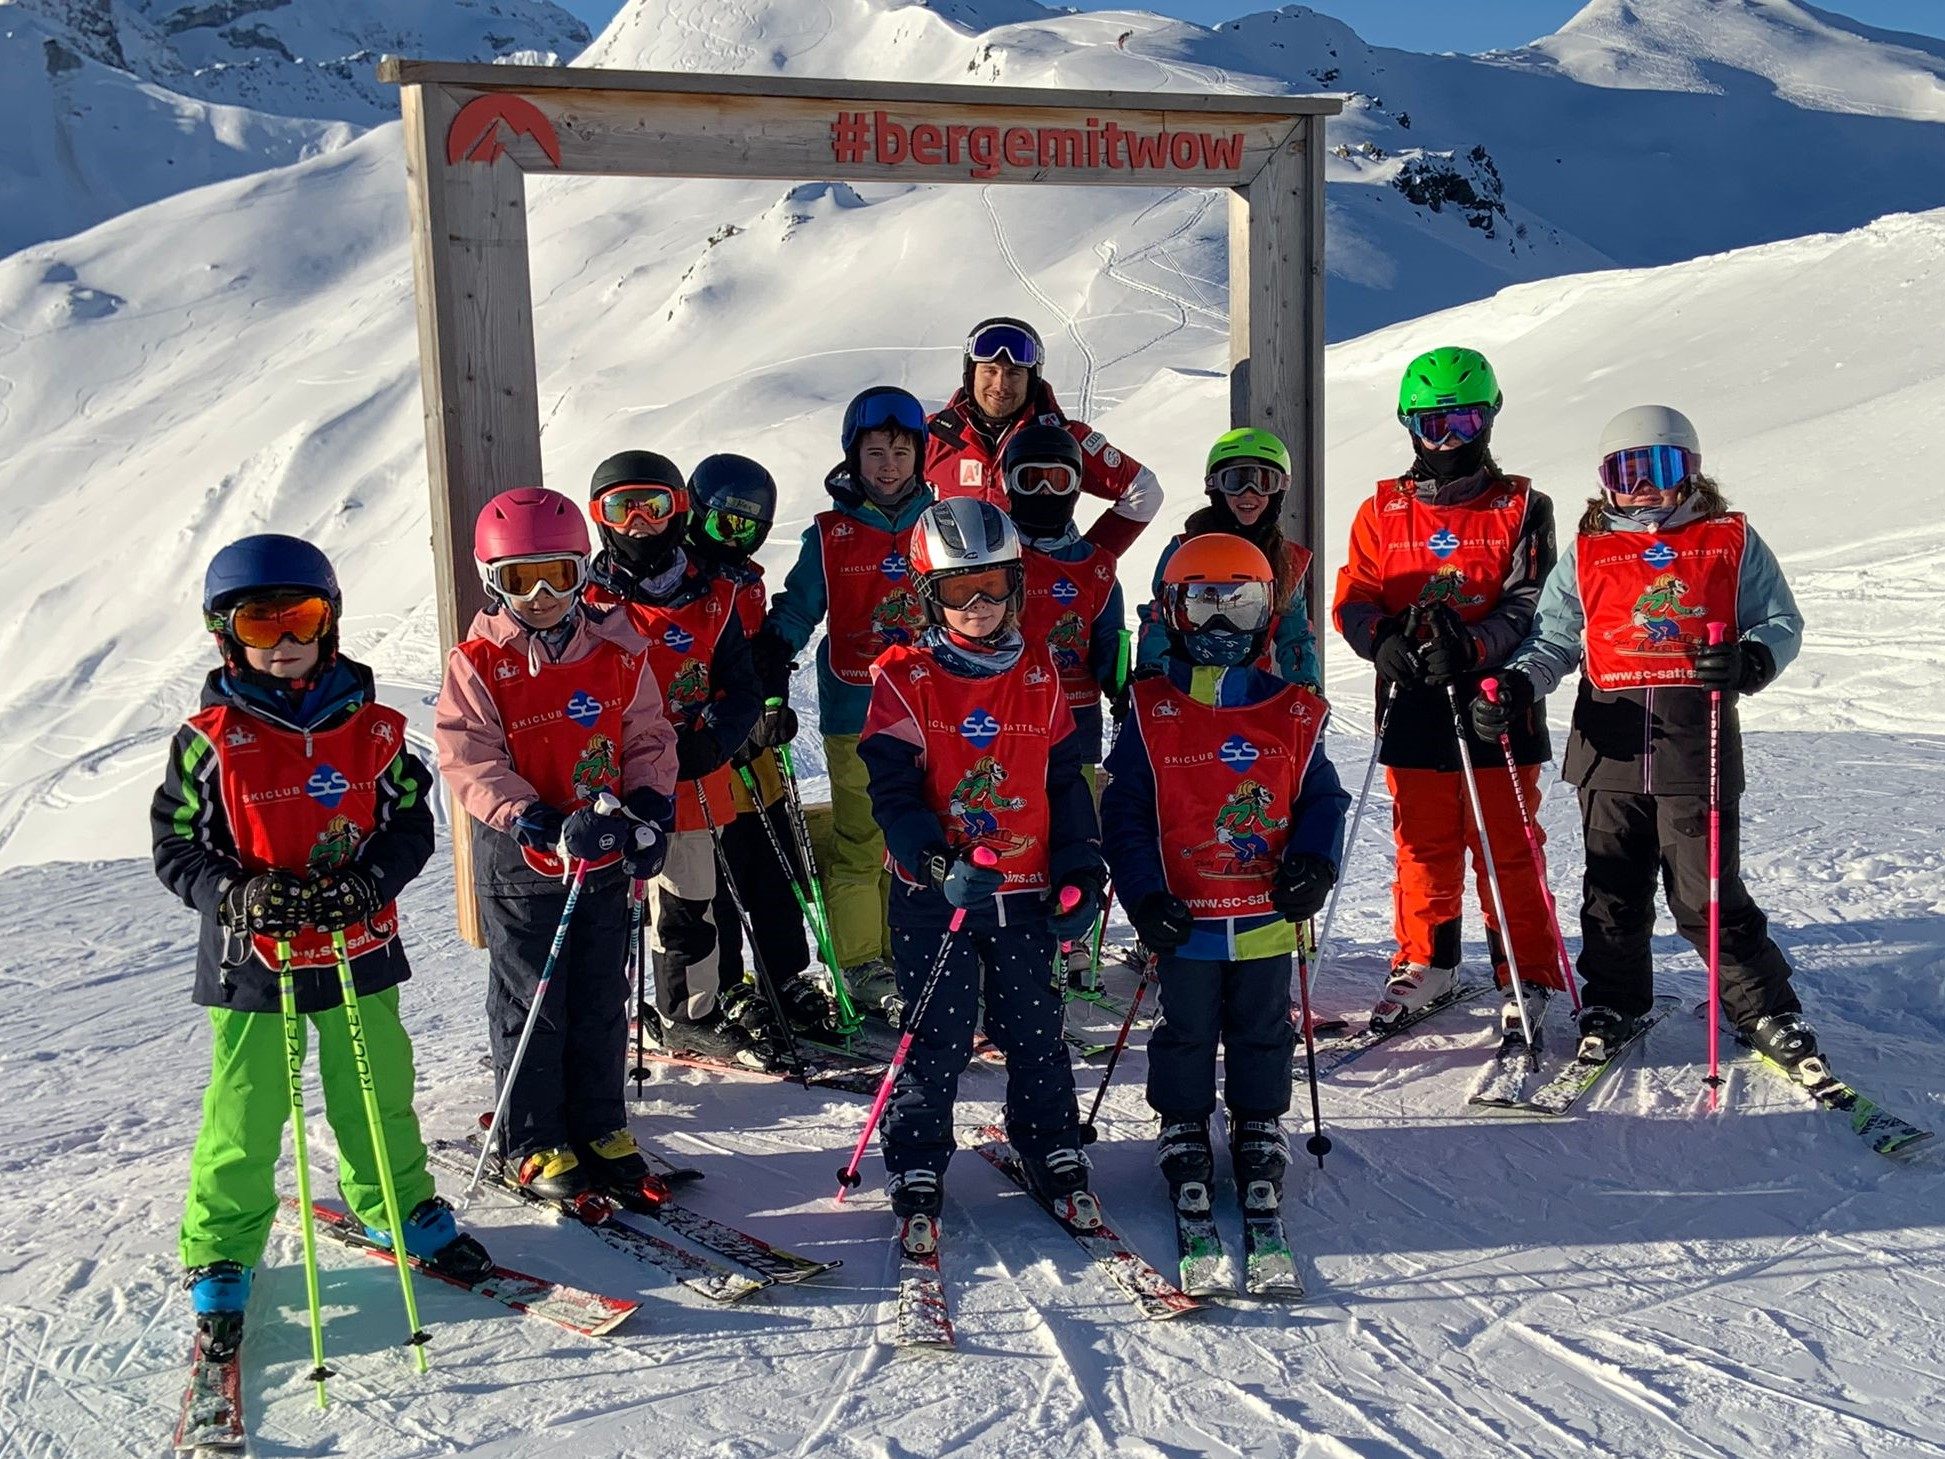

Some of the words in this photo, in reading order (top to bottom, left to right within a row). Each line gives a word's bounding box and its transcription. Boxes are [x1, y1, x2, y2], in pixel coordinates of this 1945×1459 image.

[830, 110, 1245, 179] #bergemitwow
[511, 709, 563, 730] SKICLUB
[1163, 751, 1215, 764] SKICLUB
